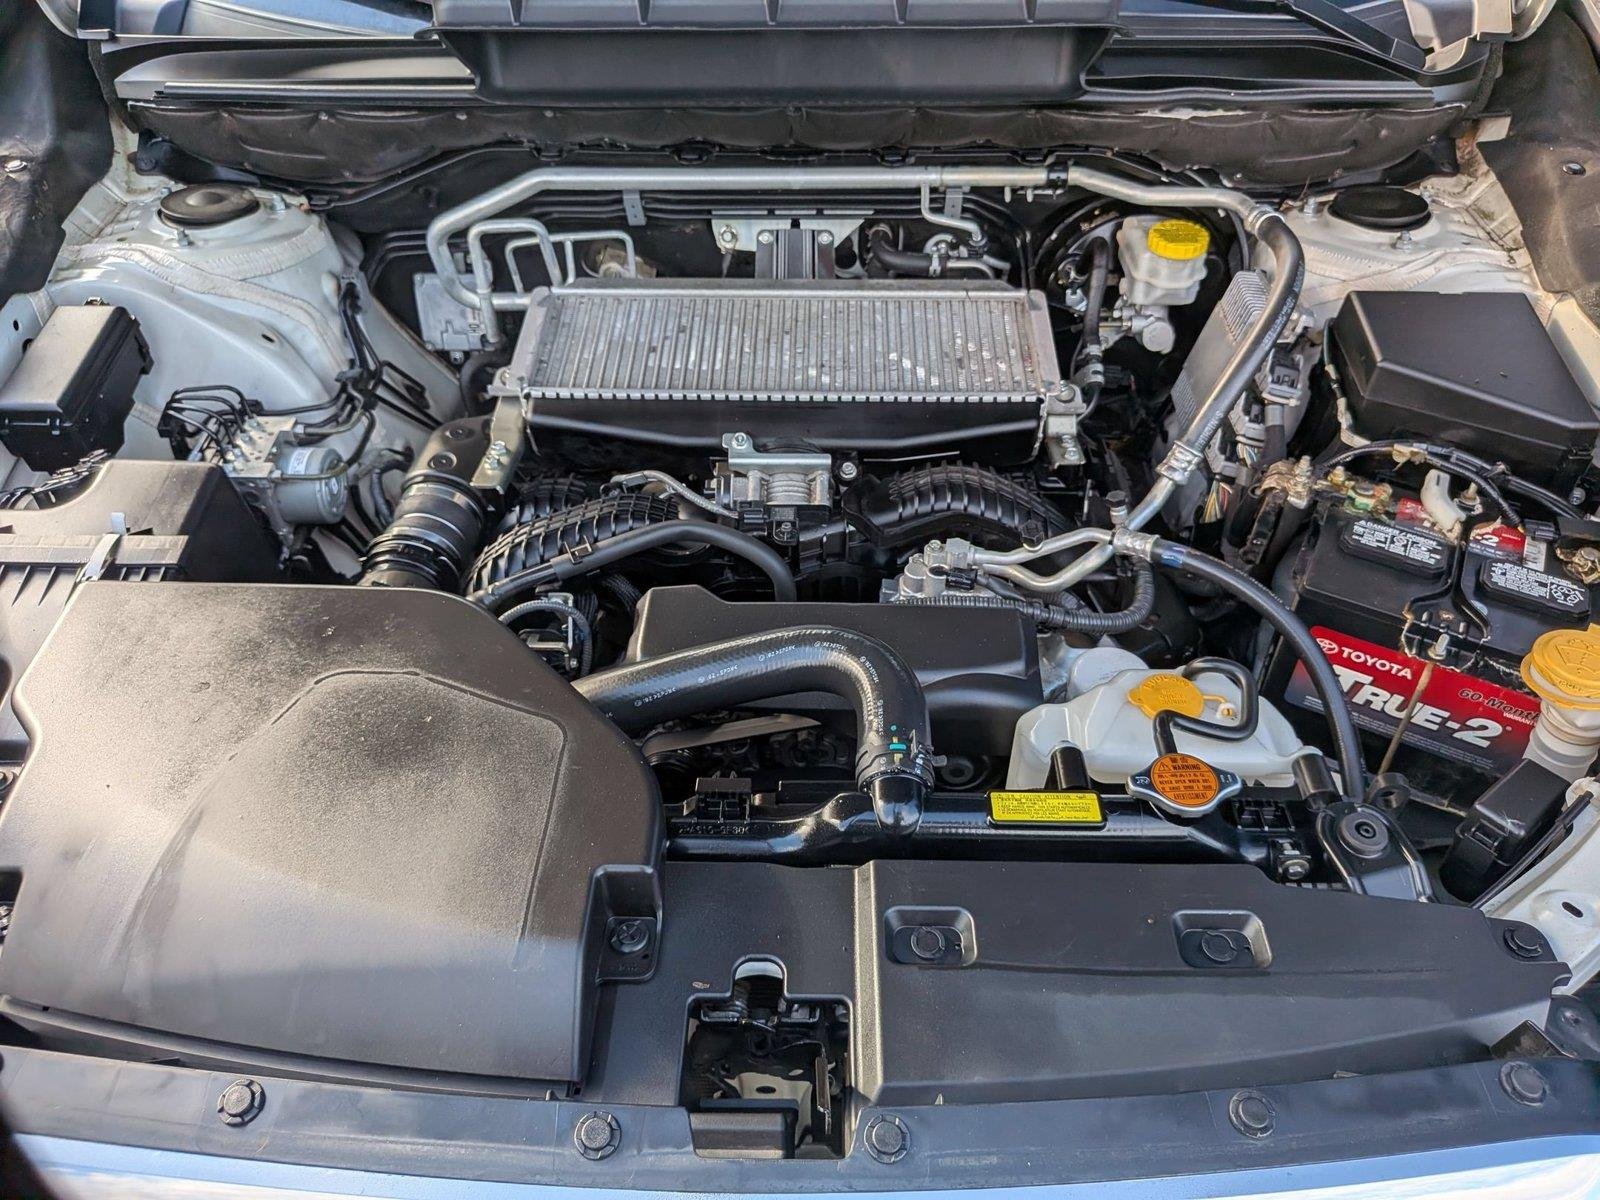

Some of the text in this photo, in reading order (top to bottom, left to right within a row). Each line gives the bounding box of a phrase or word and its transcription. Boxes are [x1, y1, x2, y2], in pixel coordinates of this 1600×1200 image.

[1367, 521, 1400, 536] DANGER
[1406, 532, 1437, 547] POISON
[1341, 646, 1412, 681] TOYOTA
[1172, 763, 1200, 771] WARNING
